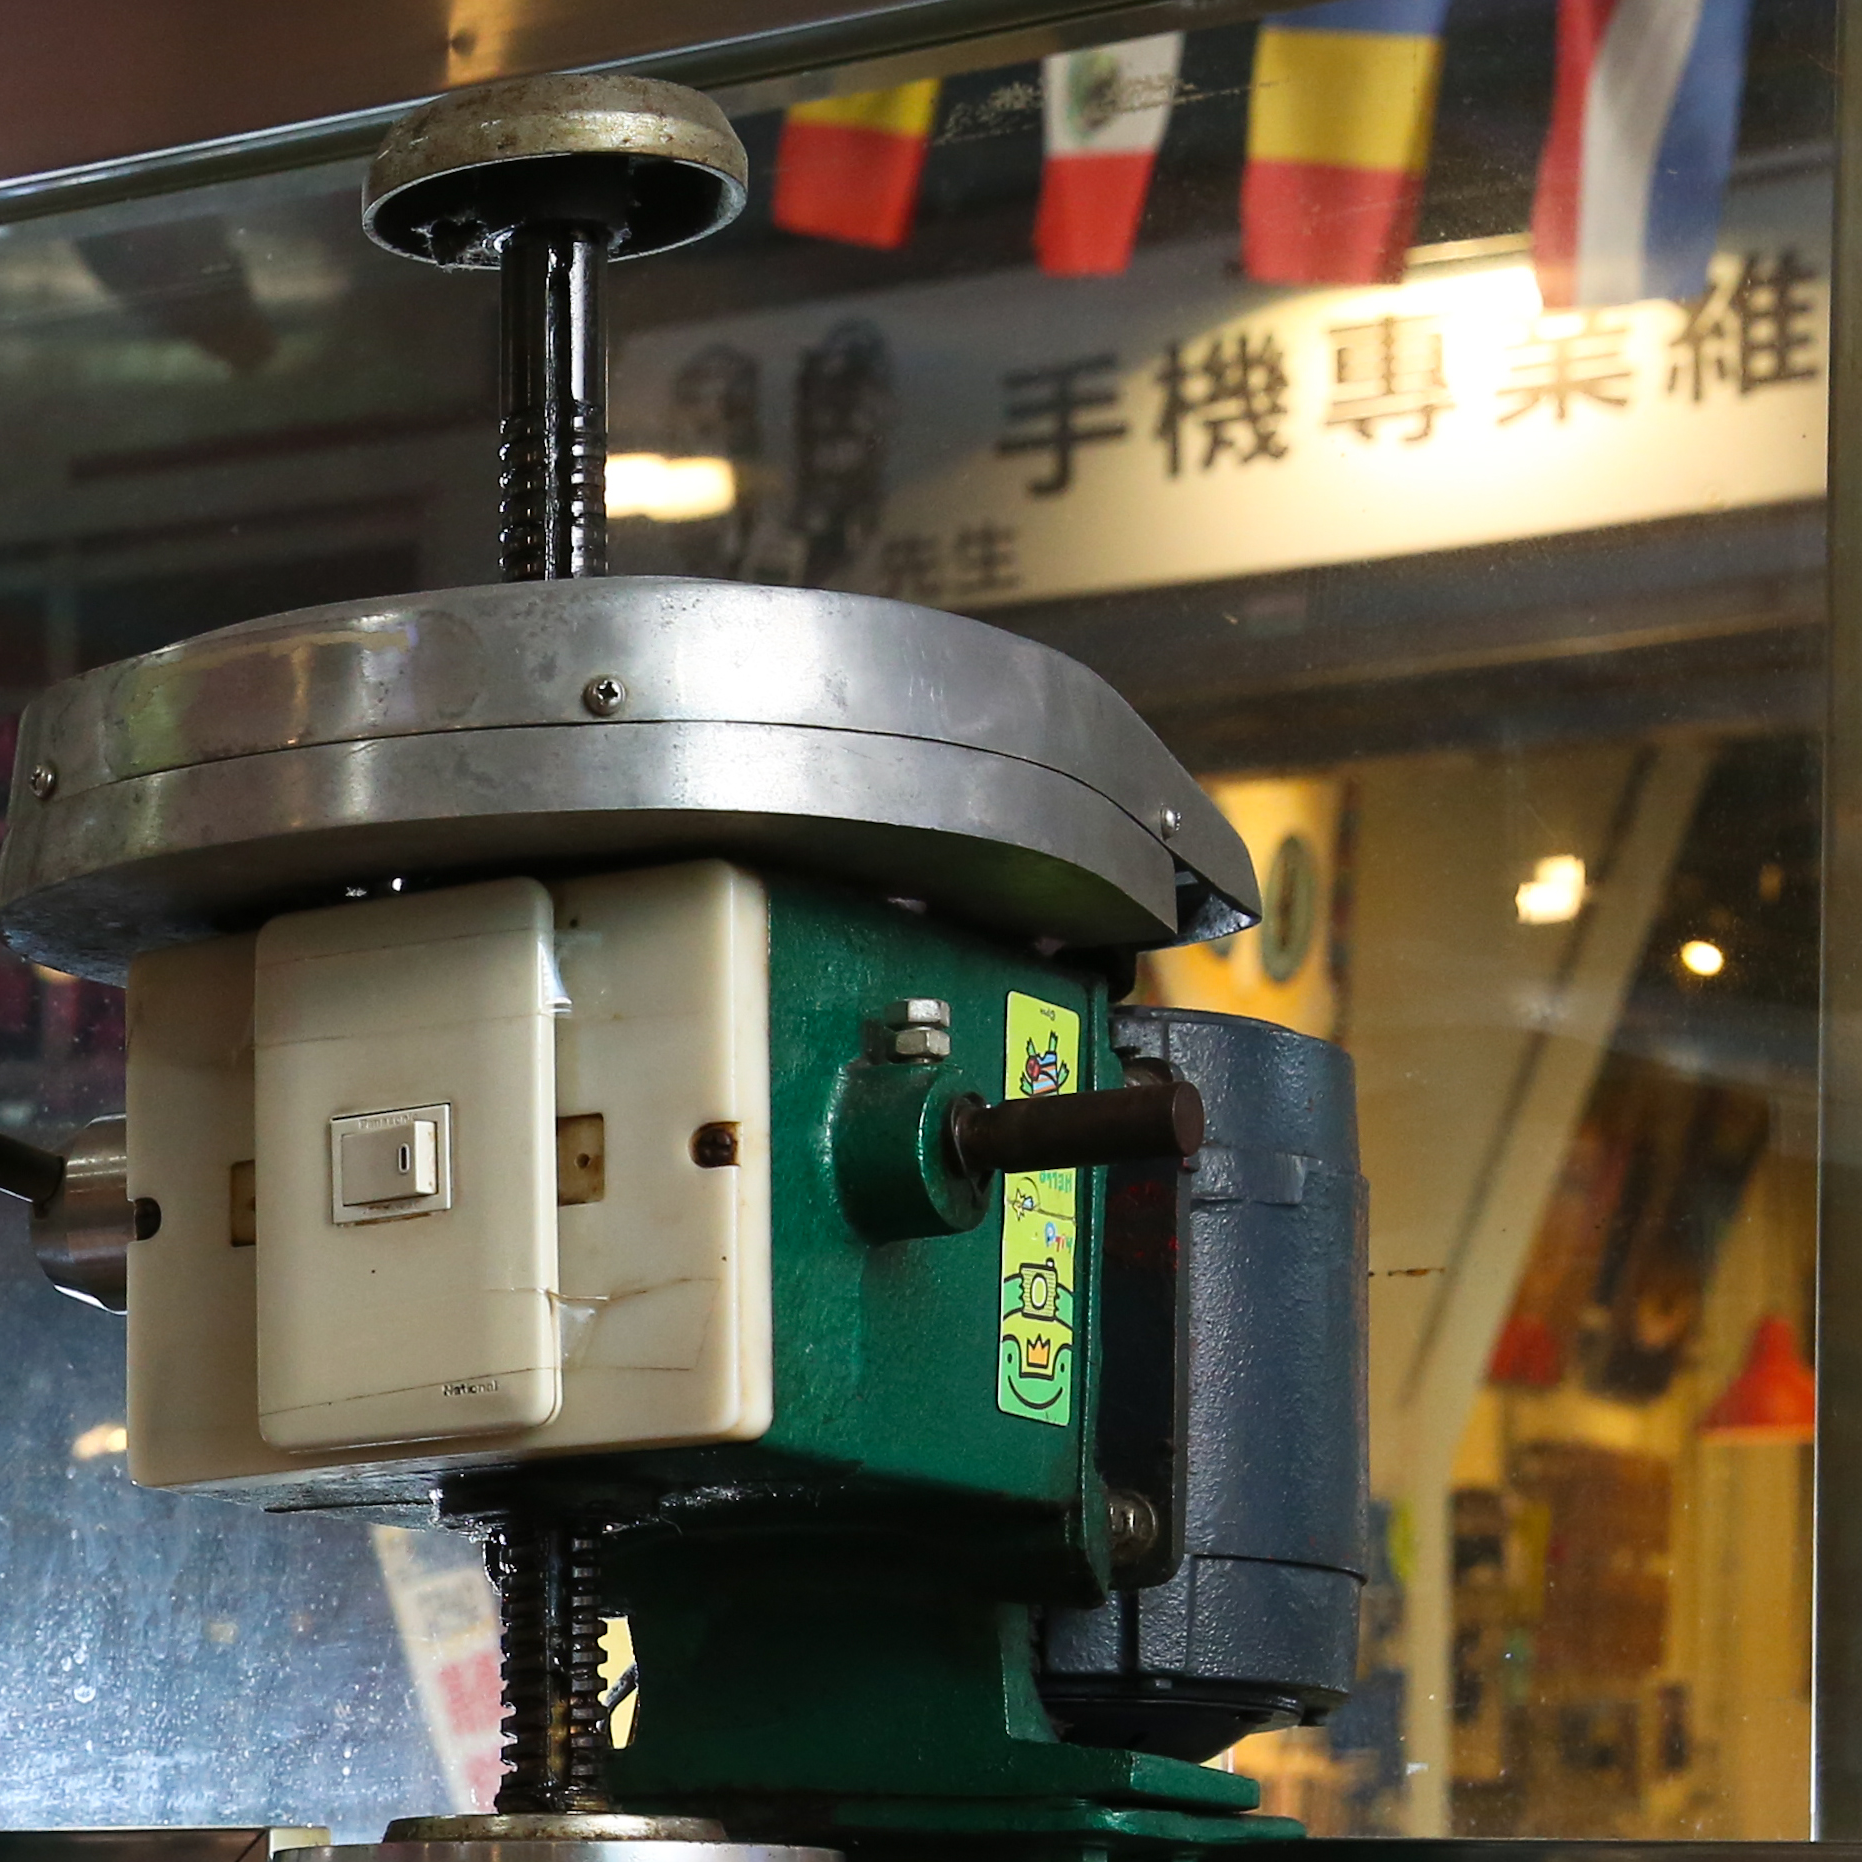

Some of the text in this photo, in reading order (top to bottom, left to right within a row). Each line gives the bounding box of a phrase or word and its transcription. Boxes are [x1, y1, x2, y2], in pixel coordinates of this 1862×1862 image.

[994, 248, 1821, 500] 手機專業維
[441, 1379, 499, 1397] National
